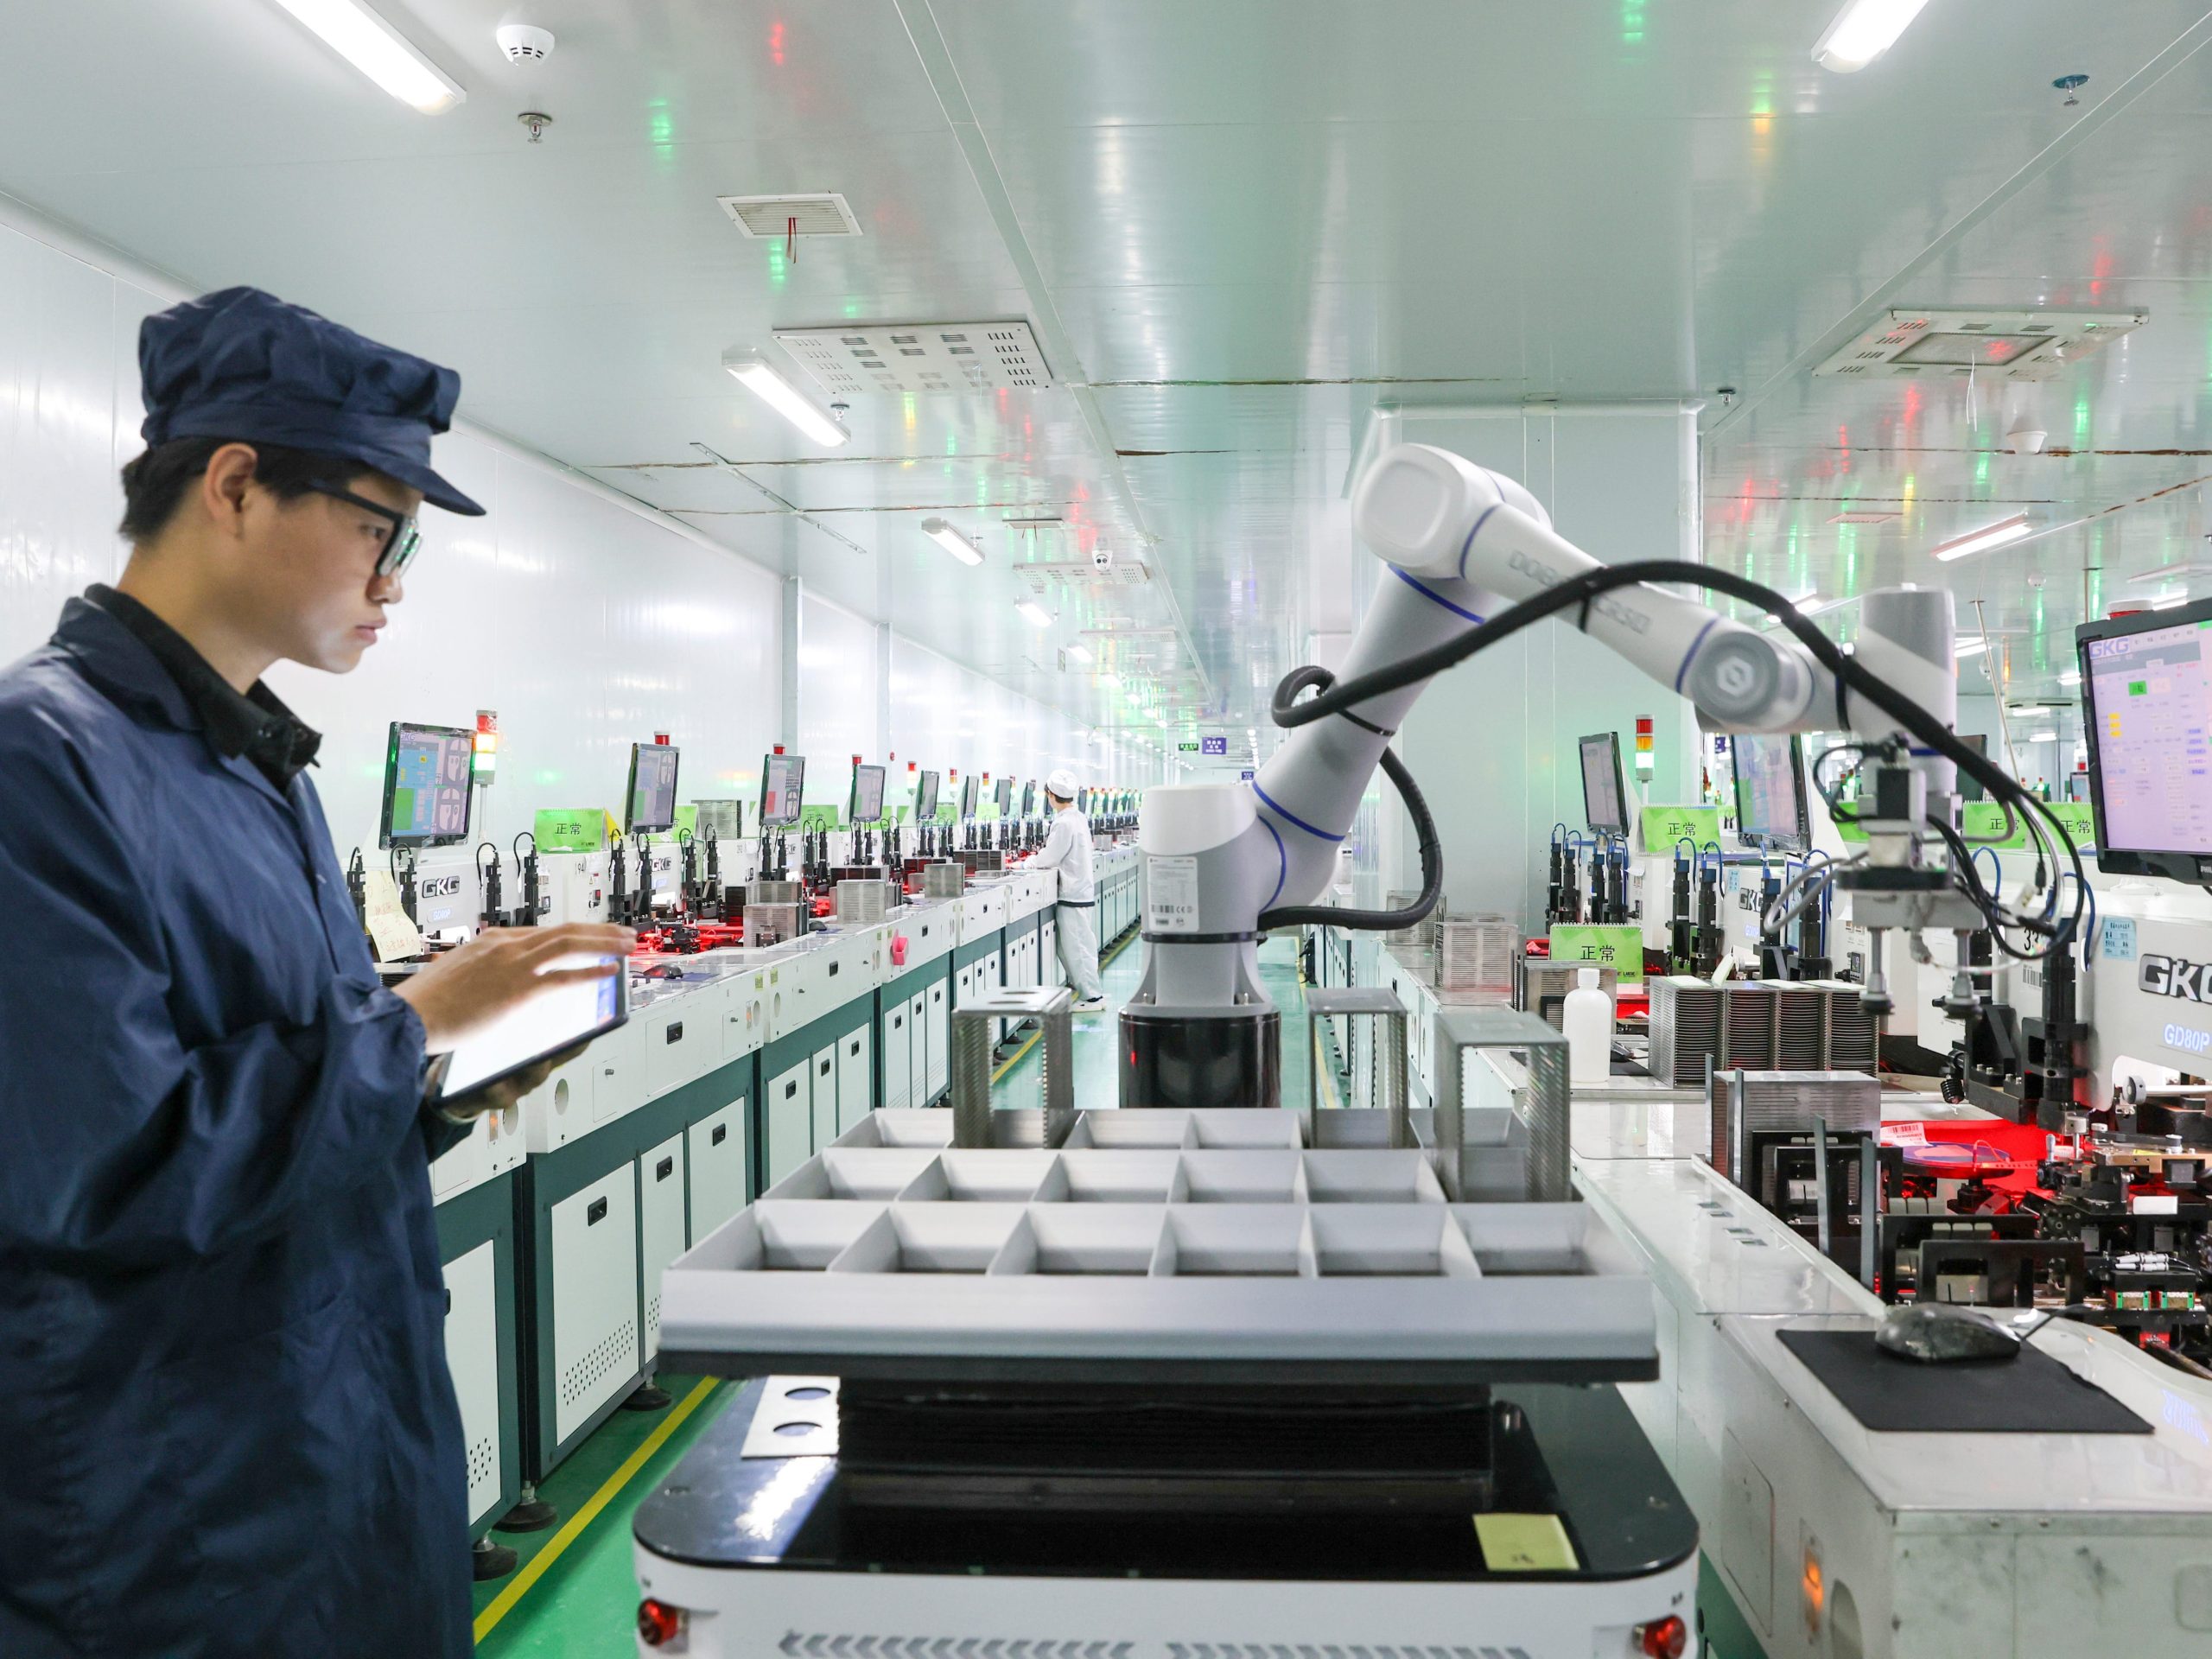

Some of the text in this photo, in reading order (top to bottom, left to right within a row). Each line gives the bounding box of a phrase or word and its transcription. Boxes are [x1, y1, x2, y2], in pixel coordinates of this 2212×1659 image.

[2089, 638, 2130, 659] GKG
[555, 822, 582, 836] 正常
[1668, 822, 1696, 836] 正常
[2061, 819, 2091, 834] 正常
[422, 875, 461, 899] GKG
[1580, 944, 1615, 963] 正常
[2164, 1023, 2210, 1052] GD80P
